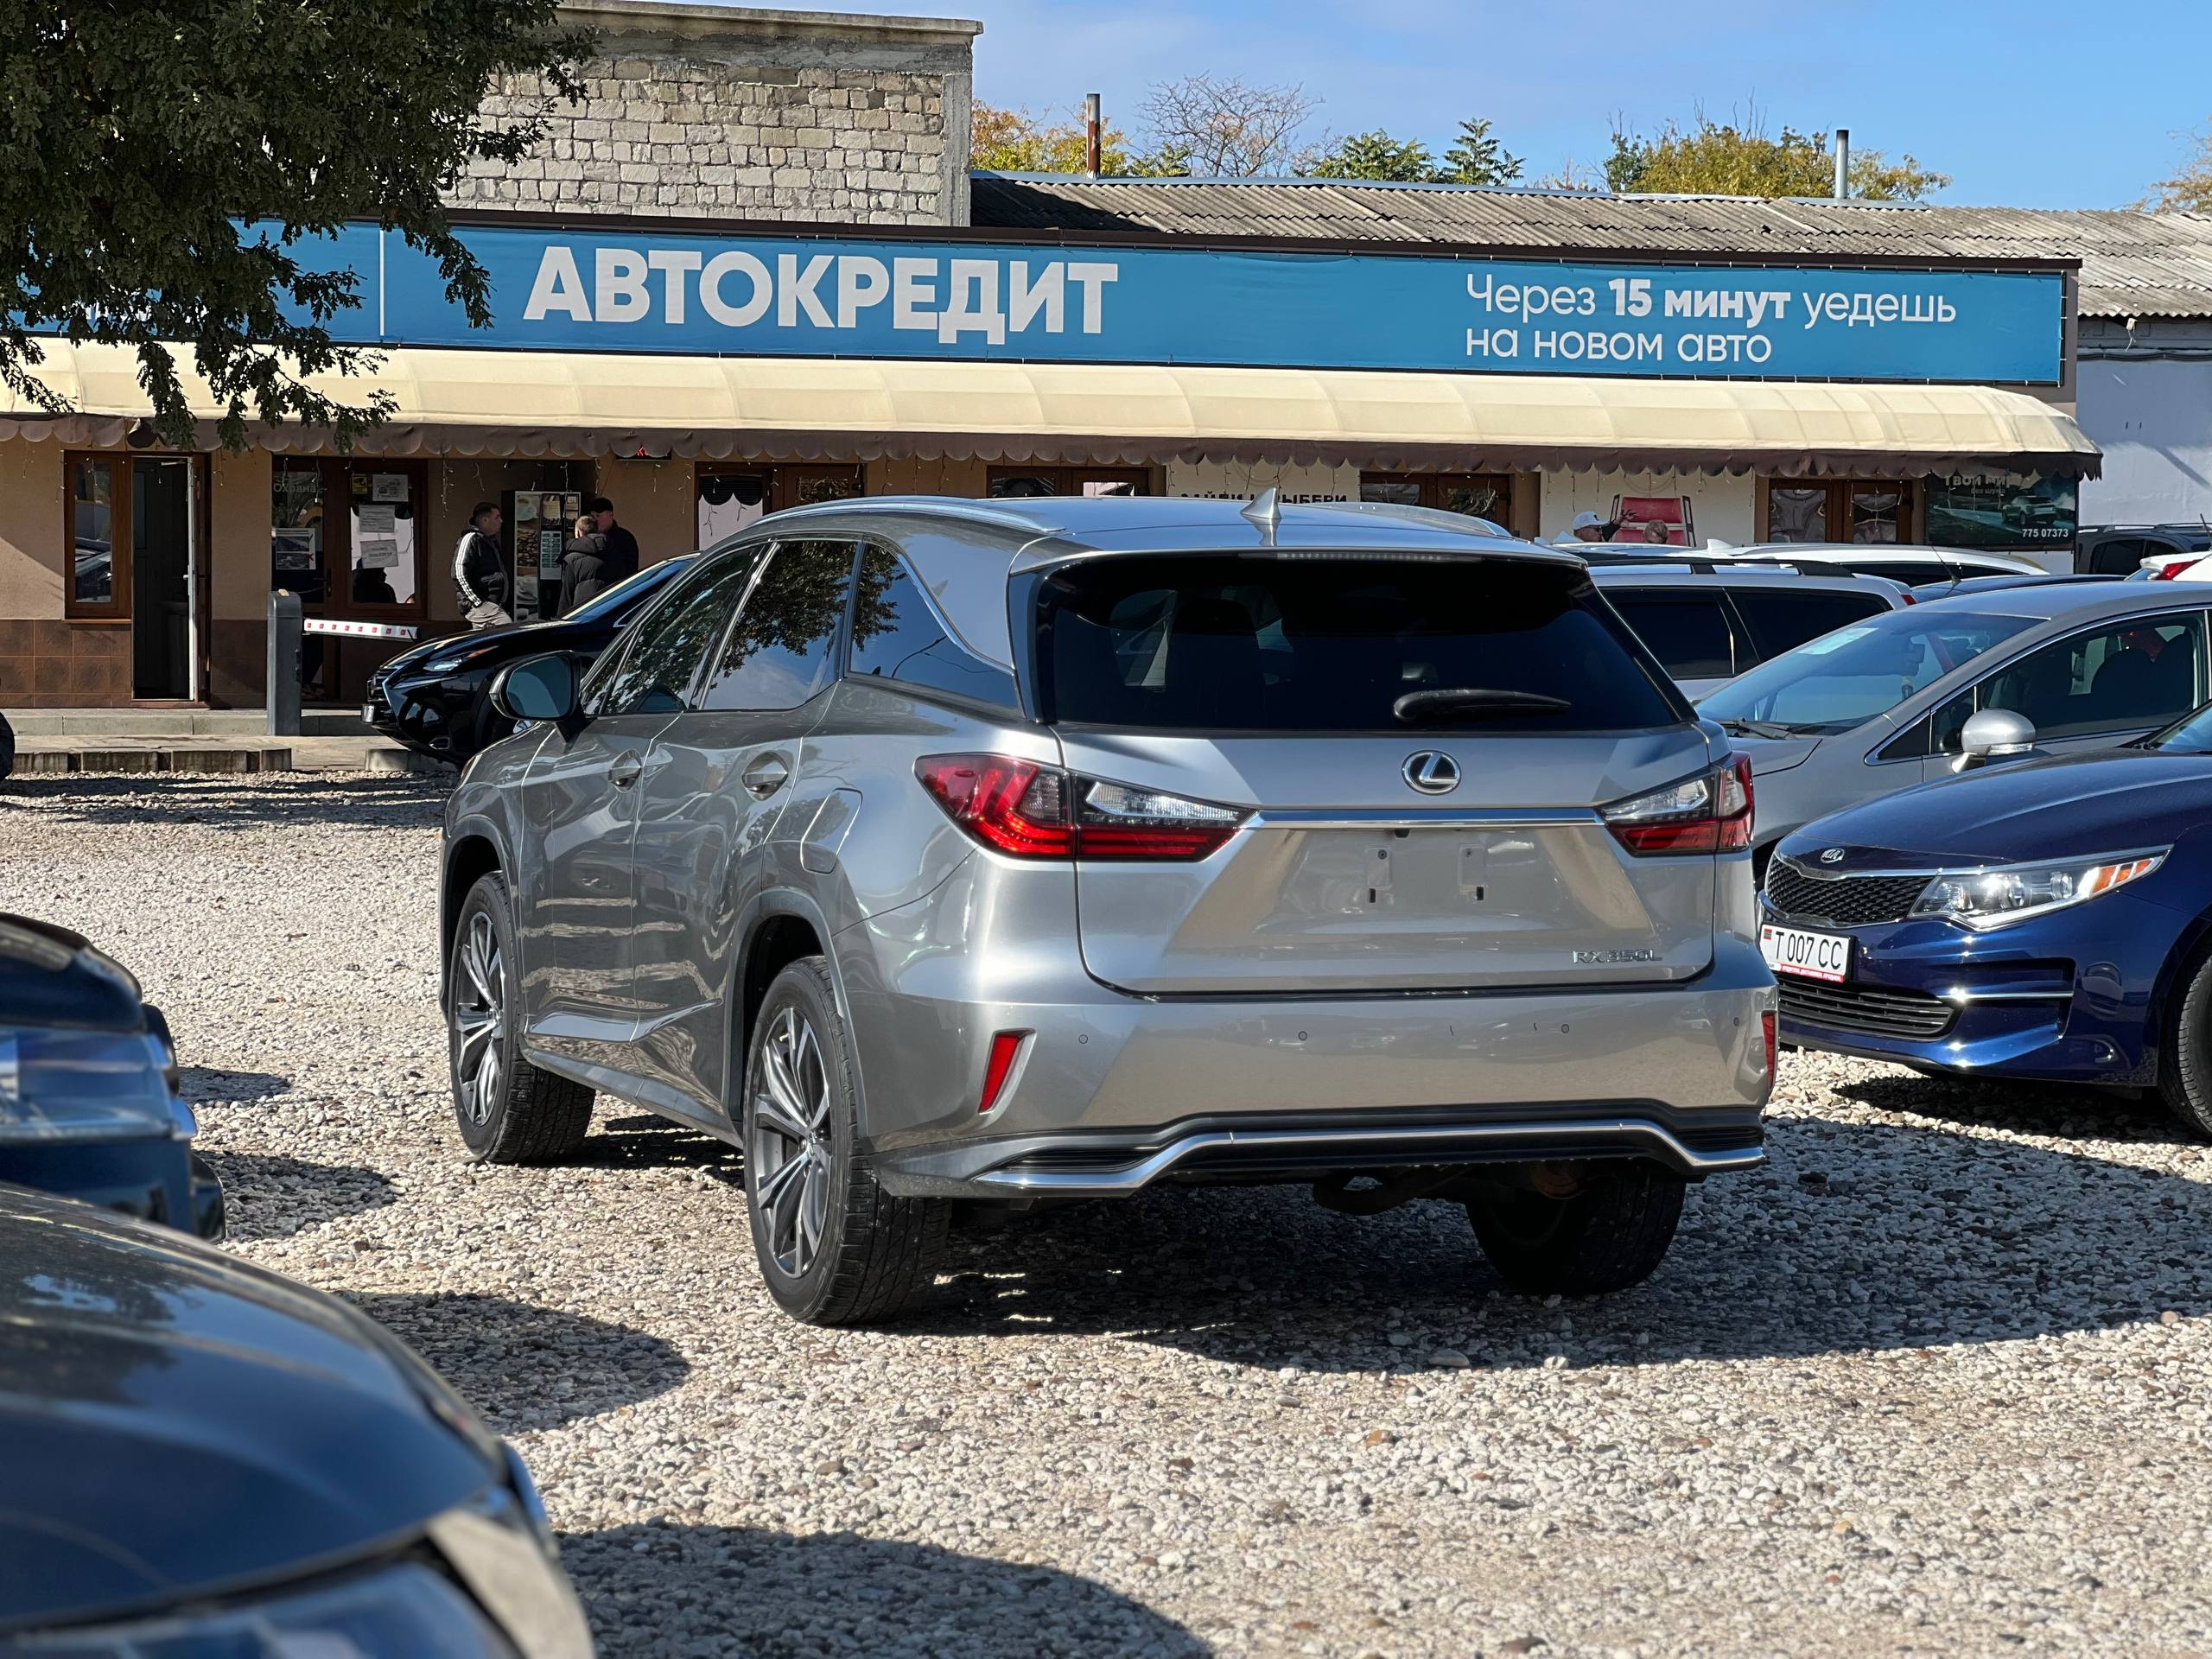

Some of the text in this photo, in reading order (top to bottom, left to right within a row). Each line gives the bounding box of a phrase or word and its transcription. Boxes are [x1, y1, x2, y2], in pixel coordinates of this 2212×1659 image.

[523, 245, 1119, 346] АВТОКРЕДИТ
[1467, 274, 1957, 329] Через 15 минут уедешь
[1466, 328, 1772, 363] на новом авто
[1278, 494, 1347, 504] ЫБЕРИ
[2022, 529, 2069, 537] 775 07373
[1776, 931, 1843, 970] T 007 CC
